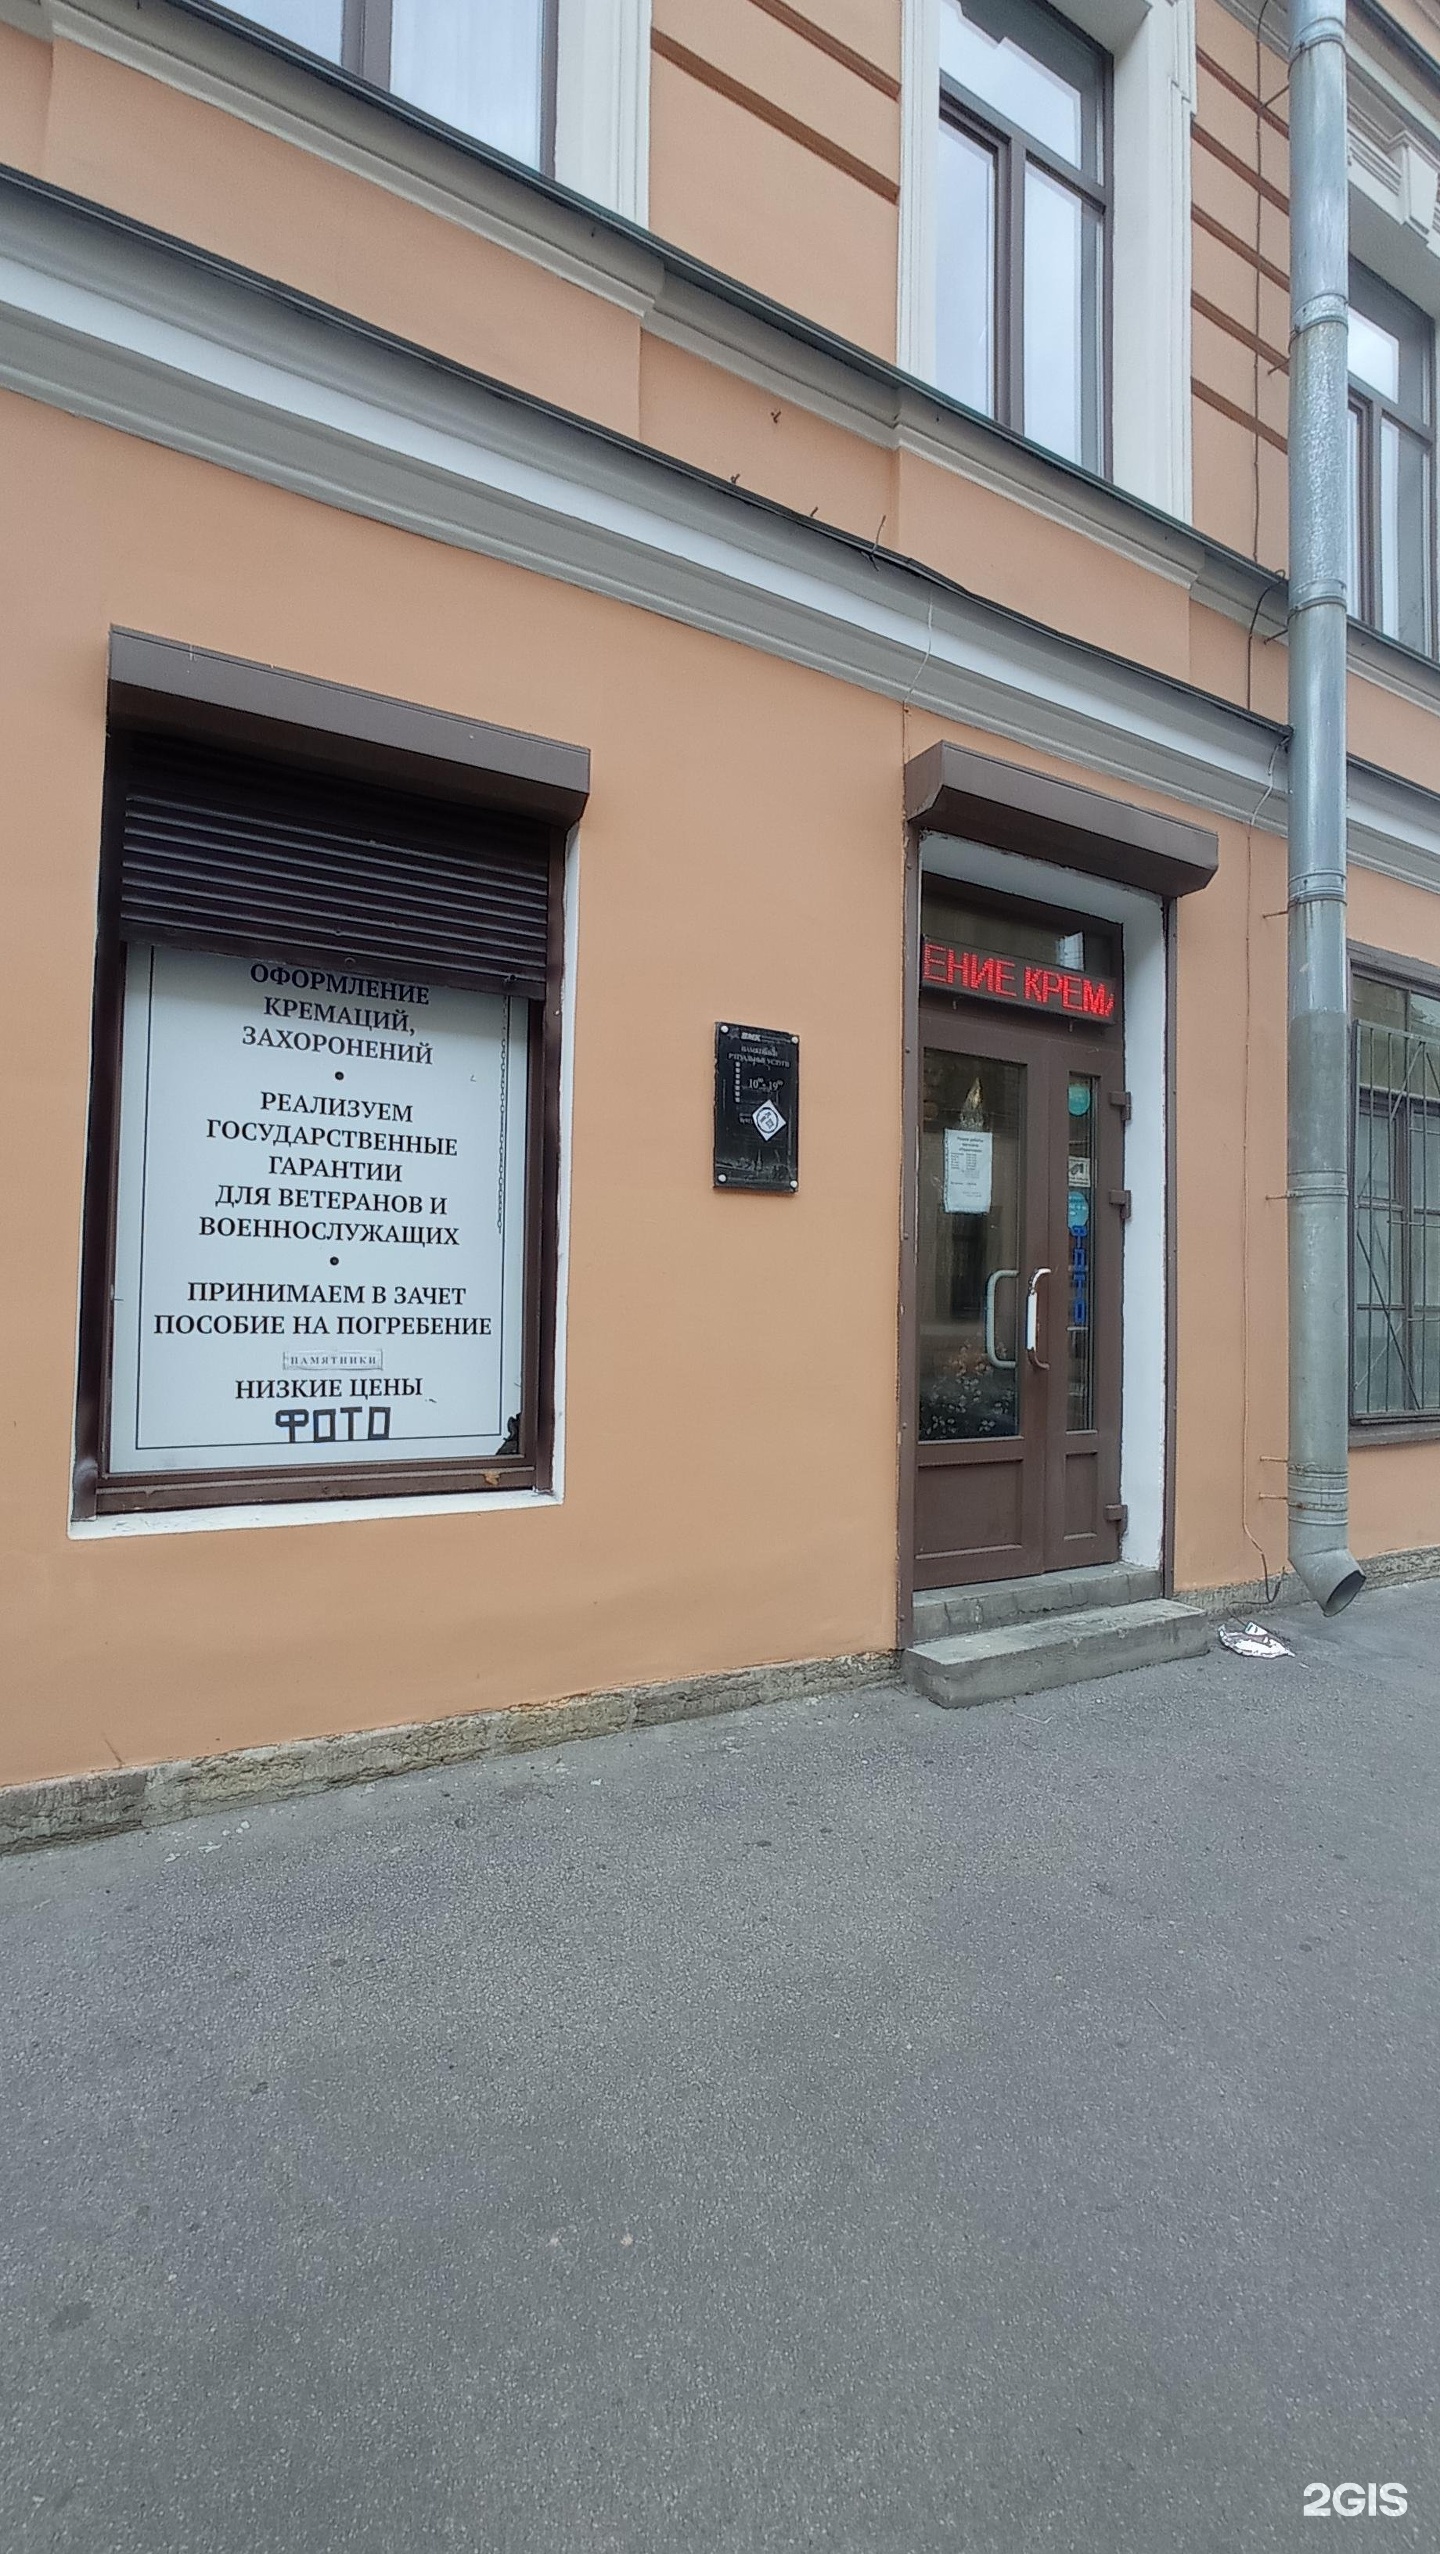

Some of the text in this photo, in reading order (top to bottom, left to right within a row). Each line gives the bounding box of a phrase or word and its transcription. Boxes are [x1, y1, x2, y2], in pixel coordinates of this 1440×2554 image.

[250, 963, 430, 1005] ОФОРМЛЕНИЕ
[264, 996, 415, 1036] КРЕМАЦИЙ,
[242, 1025, 434, 1065] ЗАХОРОНЕНИЙ
[260, 1091, 413, 1123] РЕАЛИЗУЕМ
[206, 1119, 458, 1156] ГОСУДАРСТВЕННЫЕ
[268, 1156, 403, 1183] ГАРАНТИИ
[215, 1185, 448, 1215] ДЛЯ ВЕТЕРАНОВ И
[199, 1216, 460, 1248] ВОЕННОСЛУЖАЩИХ
[187, 1282, 467, 1305] ПРИНИМАЕМ В ЗАЧЕТ
[154, 1314, 492, 1335] ПОСОБИЕ НА ПОГРЕБЕНИЕ
[290, 1355, 377, 1365] ПАМЯТНИКИ
[235, 1377, 424, 1400] НИЗКИЕ ЦЕНЫ
[275, 1406, 392, 1443] ФОТО
